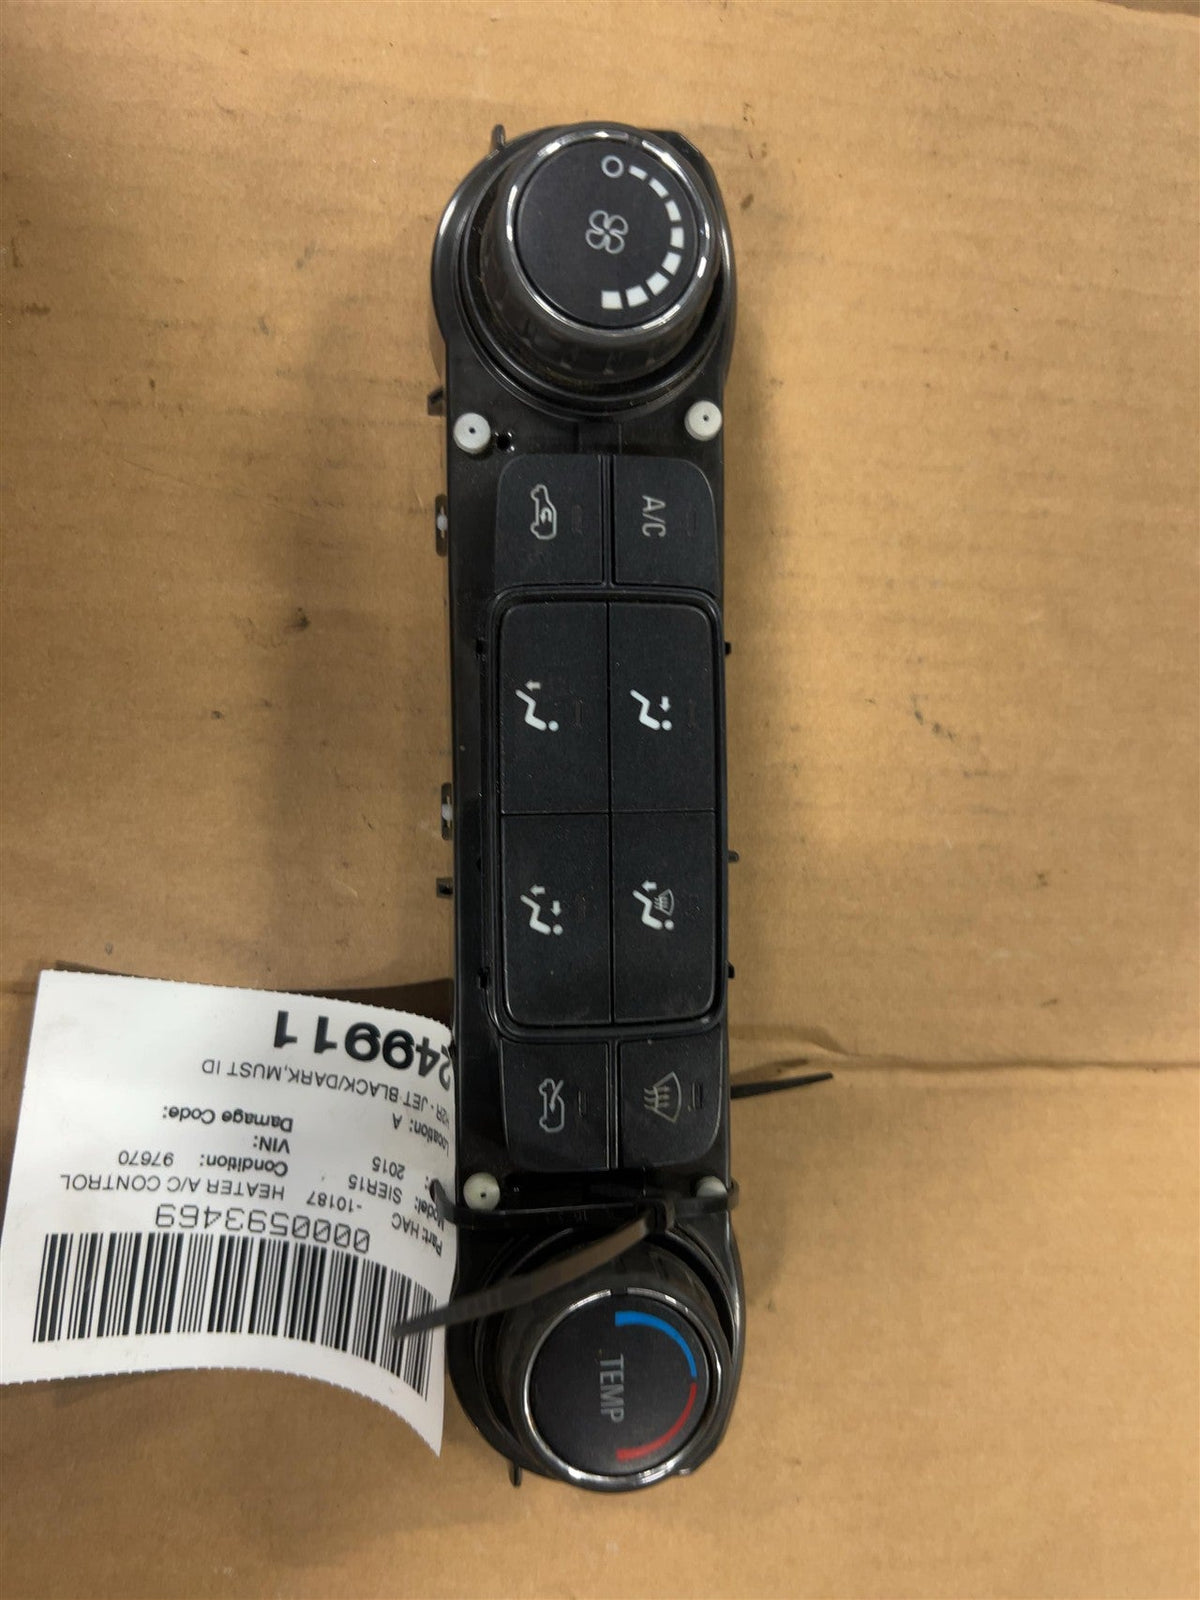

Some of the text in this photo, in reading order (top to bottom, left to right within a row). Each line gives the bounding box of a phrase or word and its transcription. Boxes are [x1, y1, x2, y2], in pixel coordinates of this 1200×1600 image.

[642, 495, 666, 537] A/C
[274, 1010, 450, 1091] 249911
[201, 1059, 221, 1075] ID
[403, 1091, 428, 1111] JET
[162, 1105, 293, 1132] Damage Code:
[253, 1135, 290, 1153] VIN:
[392, 1113, 449, 1157] Location: A
[118, 1150, 288, 1177] Condition: 97670
[372, 1156, 405, 1180] 2015
[348, 1174, 402, 1205] SIER15
[60, 1174, 443, 1257] Part: HAC -10187 HEATER A/C CONTROL
[155, 1203, 371, 1254] 0000593469
[600, 1352, 625, 1423] TEMP
